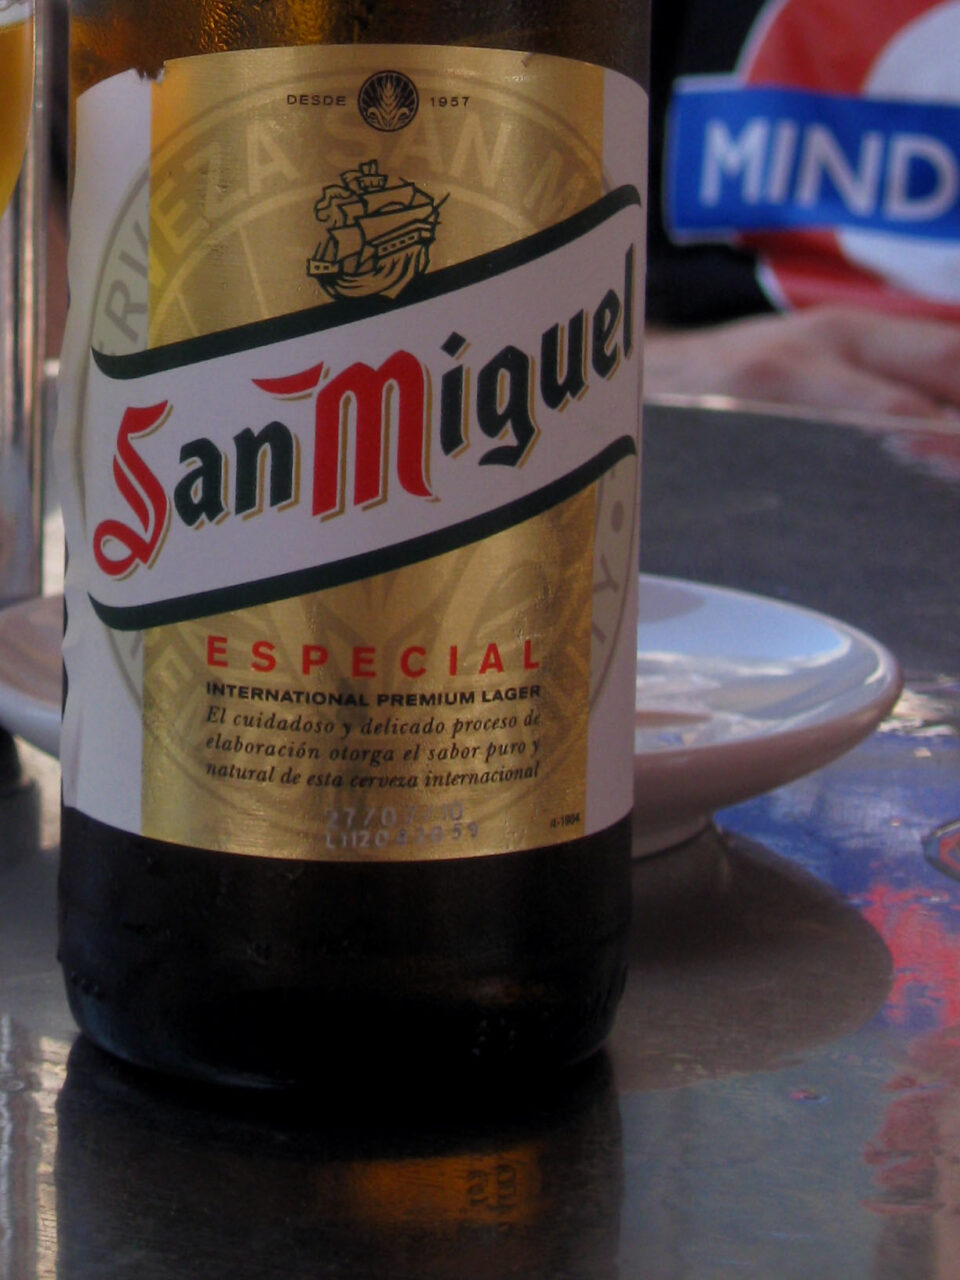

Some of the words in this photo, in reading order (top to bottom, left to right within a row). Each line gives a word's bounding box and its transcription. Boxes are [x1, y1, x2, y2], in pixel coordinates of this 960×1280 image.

[286, 93, 347, 107] DESDE
[429, 95, 471, 108] 1957
[698, 117, 958, 223] MIND
[92, 399, 304, 580] San
[251, 243, 638, 522] Miguel
[206, 635, 540, 679] ESPECIAL
[206, 681, 370, 707] INTERNATIONAL
[377, 691, 475, 707] PREMIUM
[481, 685, 541, 703] LAGER
[206, 705, 227, 725] El
[233, 712, 335, 734] cuidadoso
[340, 722, 352, 740] y
[360, 716, 445, 736] delicado
[451, 714, 518, 739] proceso
[524, 709, 540, 727] de
[206, 733, 320, 760] elaboración
[329, 745, 394, 767] otorga
[403, 744, 421, 761] el
[427, 742, 481, 761] sabor
[485, 740, 527, 763] puro
[531, 740, 541, 757] y
[206, 762, 275, 784] natural
[280, 767, 302, 785] de
[307, 770, 343, 787] esta
[350, 773, 419, 789] cerveza
[424, 763, 540, 789] internacional
